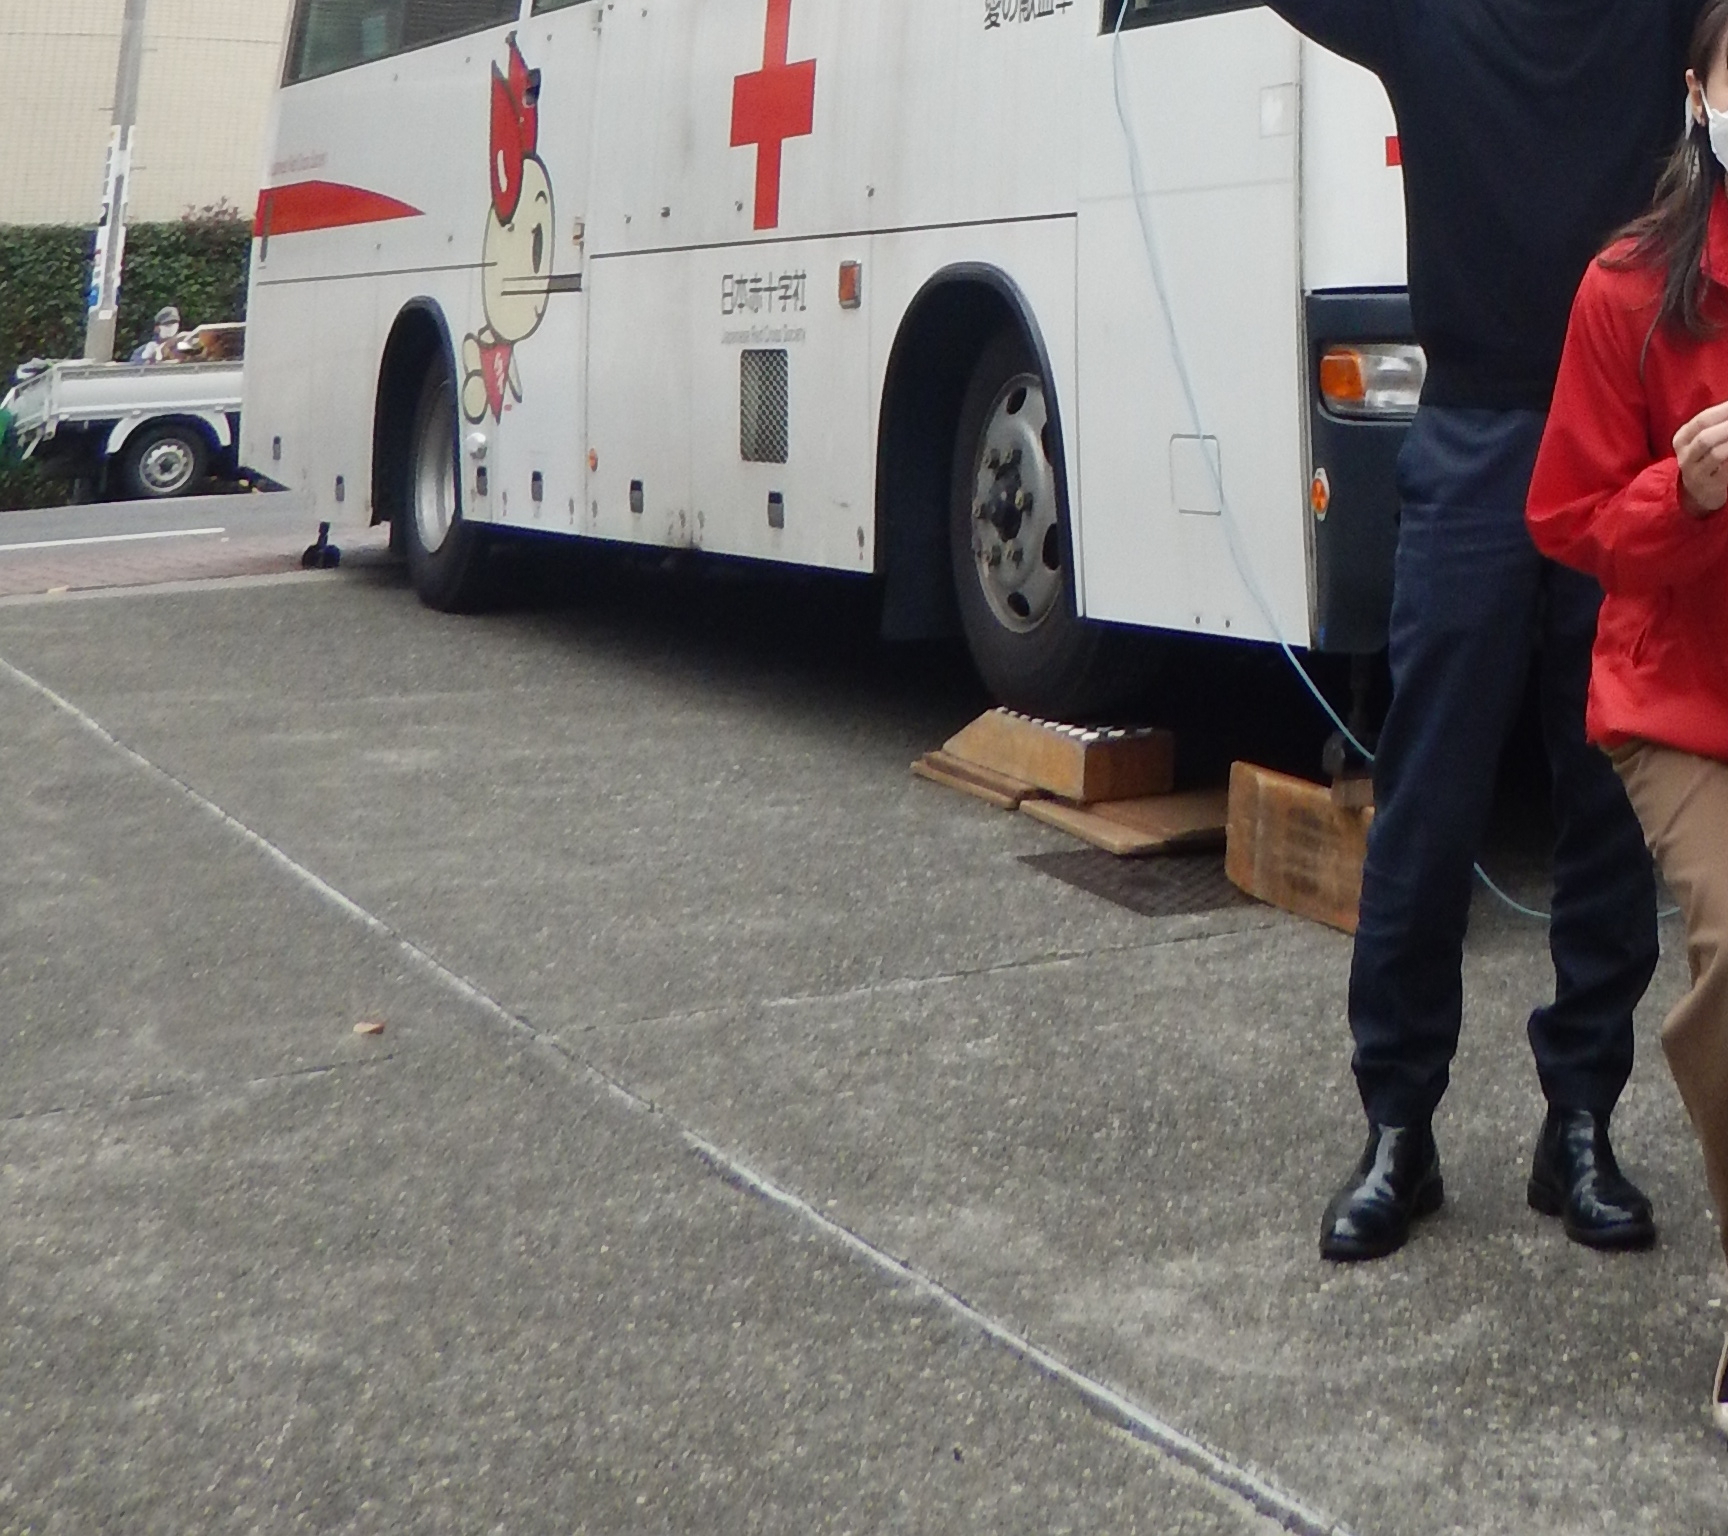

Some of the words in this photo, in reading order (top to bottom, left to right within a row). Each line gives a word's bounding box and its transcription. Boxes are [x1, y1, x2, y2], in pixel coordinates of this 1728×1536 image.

[721, 269, 807, 316] 日本赤十字社
